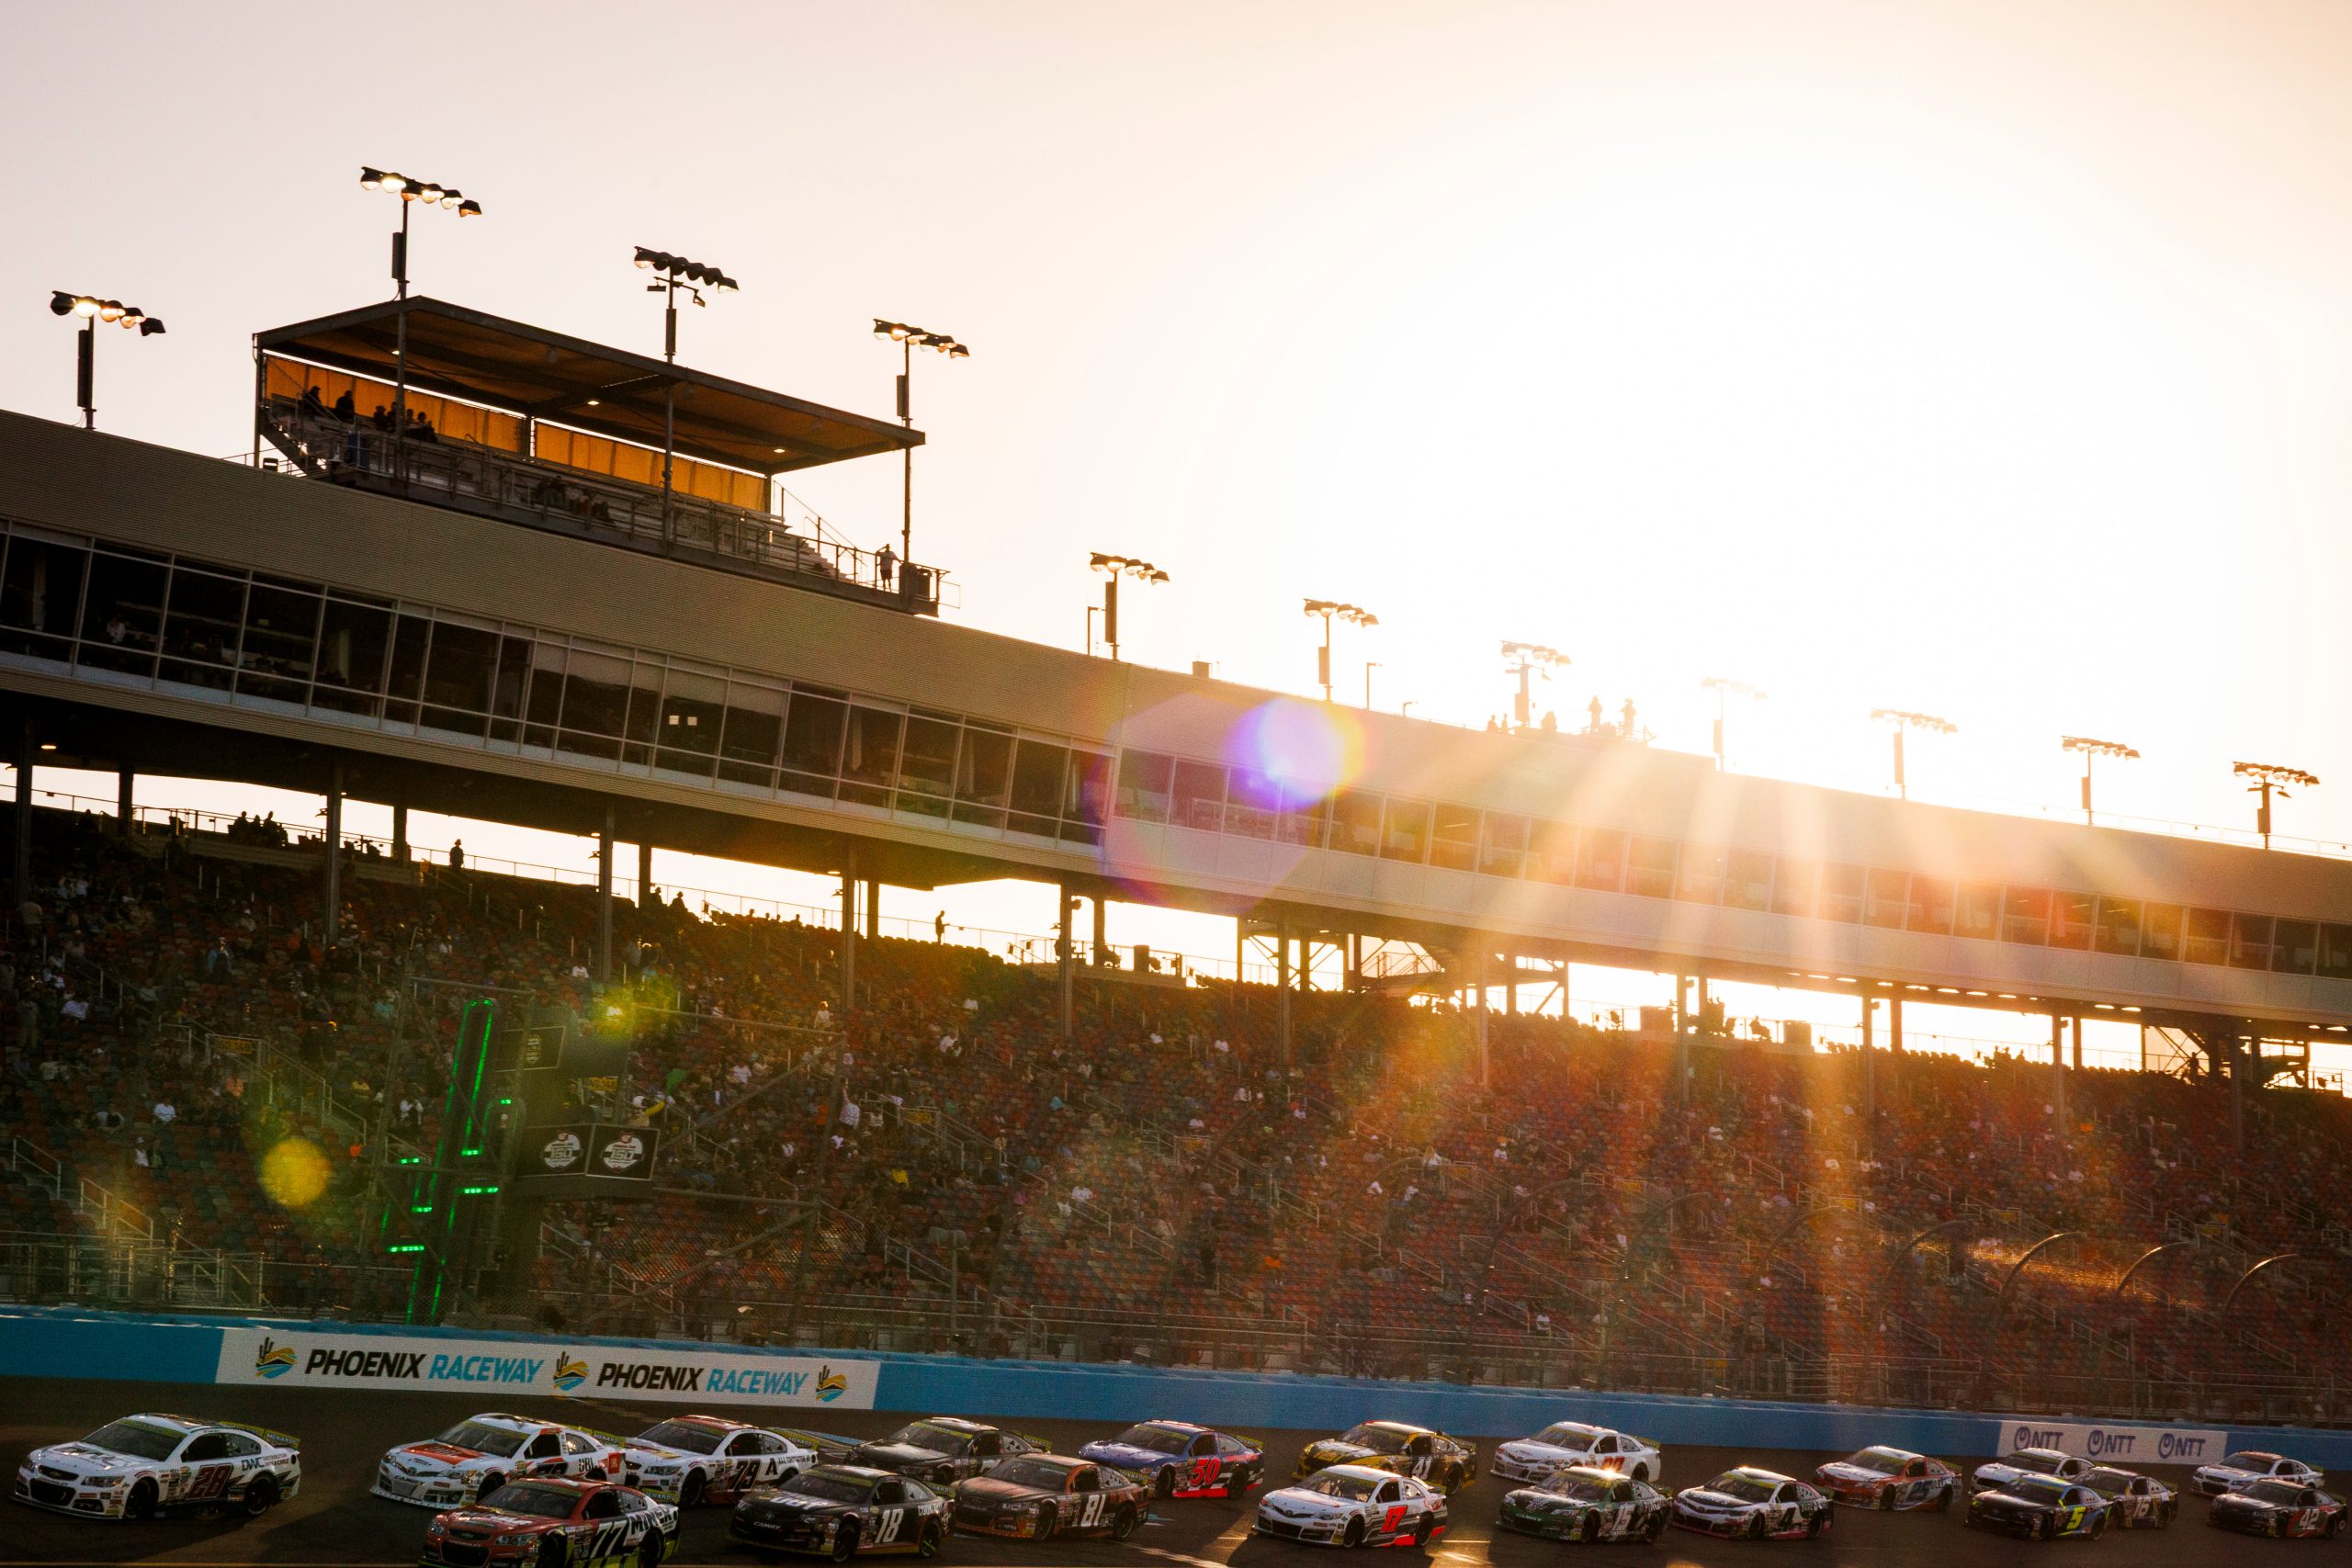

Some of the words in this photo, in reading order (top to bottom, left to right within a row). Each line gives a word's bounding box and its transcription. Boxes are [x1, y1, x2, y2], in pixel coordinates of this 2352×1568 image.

[304, 1348, 426, 1379] PHOENIX
[428, 1354, 545, 1383] RACEWAY
[596, 1361, 705, 1392] PHOENIX
[706, 1368, 809, 1396] RACEWAY
[2031, 1430, 2064, 1450] NTT
[2104, 1434, 2136, 1453] NTT
[2175, 1438, 2206, 1457] NTT
[241, 1456, 265, 1472] DWC
[1190, 1457, 1221, 1486] 50
[1412, 1456, 1433, 1480] 41
[185, 1462, 233, 1500] 28
[1080, 1494, 1107, 1528] 81
[2068, 1506, 2086, 1529] 5
[2299, 1508, 2320, 1530] 42
[875, 1508, 904, 1543] 18
[589, 1519, 628, 1559] 77
